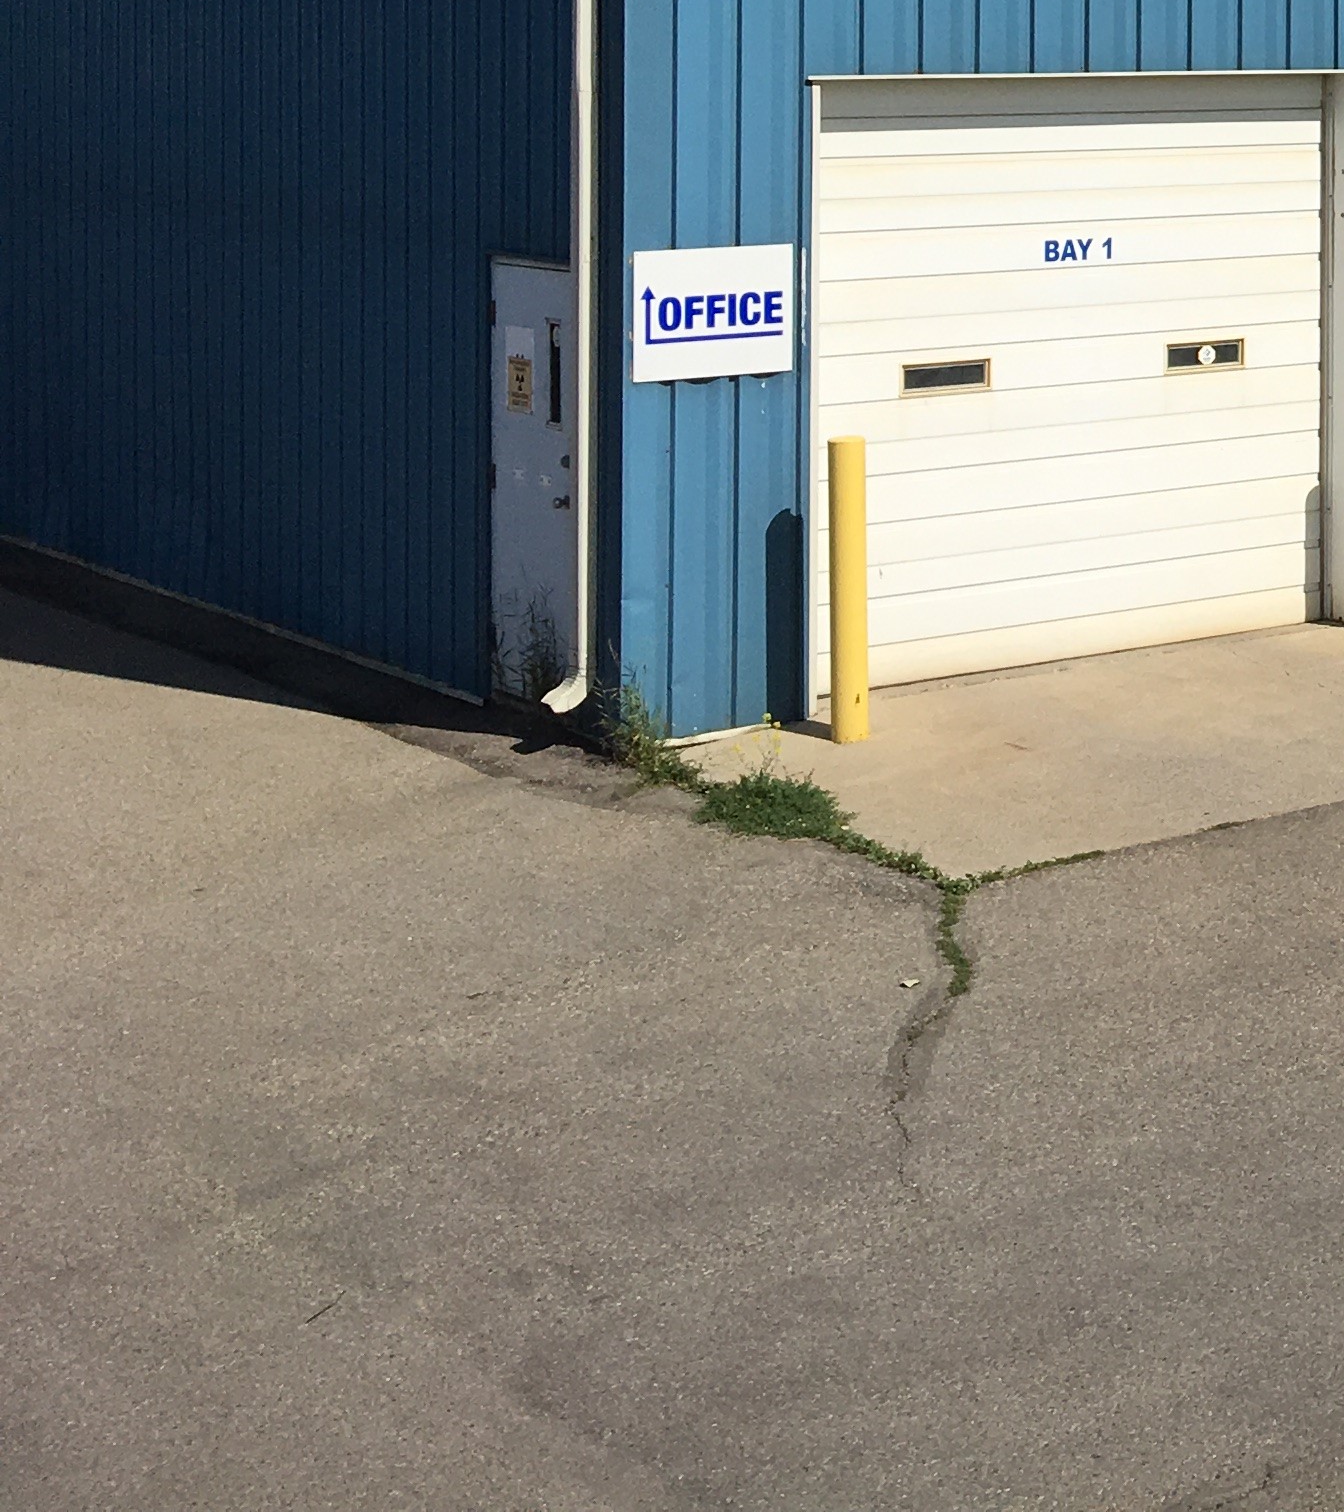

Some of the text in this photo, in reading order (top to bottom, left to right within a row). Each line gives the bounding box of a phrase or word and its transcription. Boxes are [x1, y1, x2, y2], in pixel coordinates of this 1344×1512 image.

[1044, 237, 1112, 262] BAY 1
[658, 290, 784, 332] OFFICE
